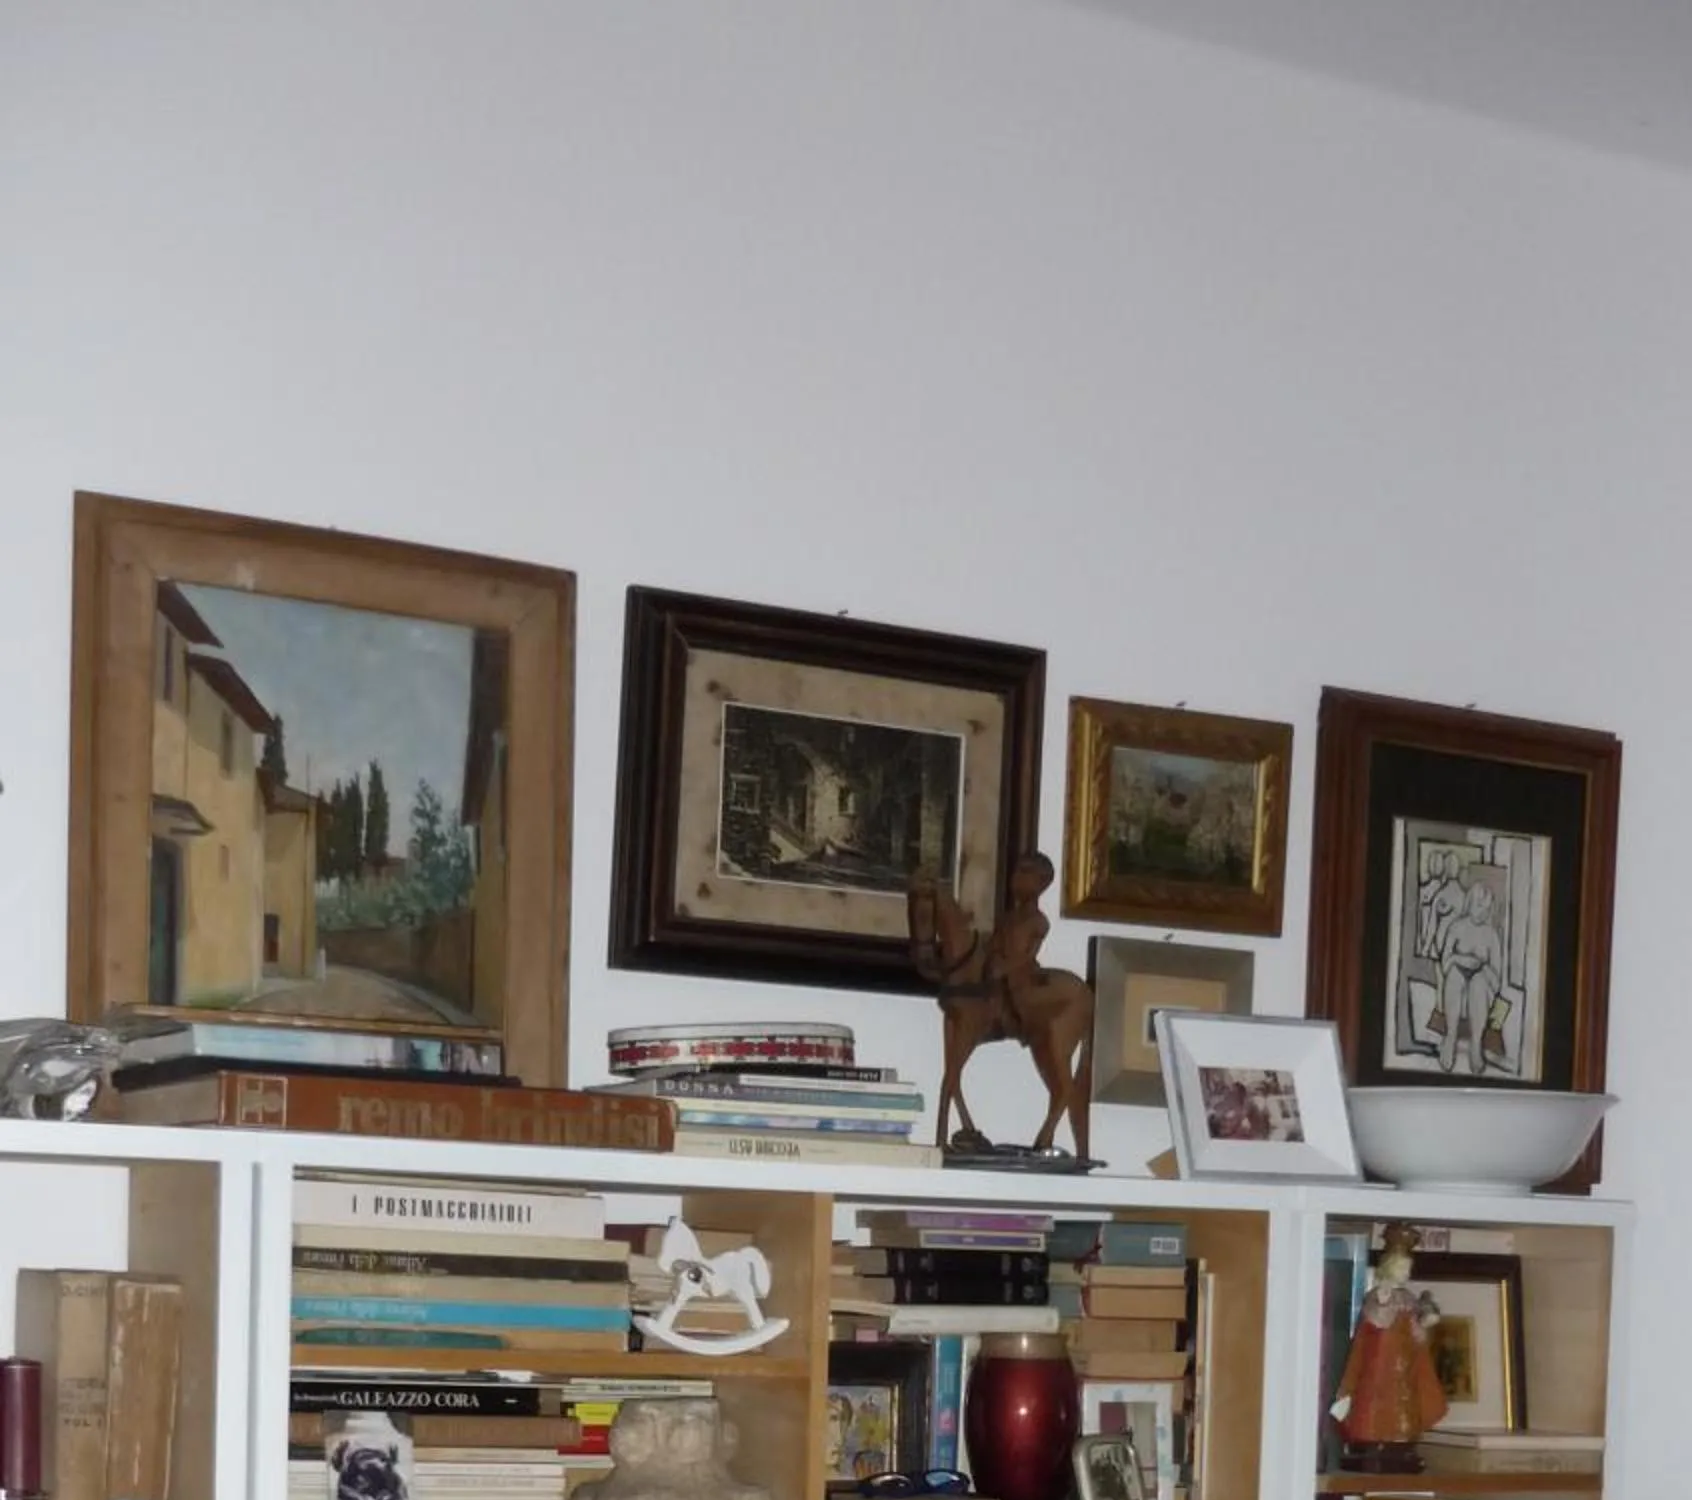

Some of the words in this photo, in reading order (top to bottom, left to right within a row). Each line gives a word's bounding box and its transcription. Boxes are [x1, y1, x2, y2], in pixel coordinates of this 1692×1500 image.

[664, 1079, 734, 1096] DONNA
[337, 1094, 464, 1138] remo
[481, 1086, 660, 1149] brindisi
[352, 1195, 357, 1214] I
[373, 1195, 532, 1224] POSTMACCHIAIOLI
[339, 1391, 430, 1407] GALEAZZO
[434, 1391, 480, 1408] CORA
